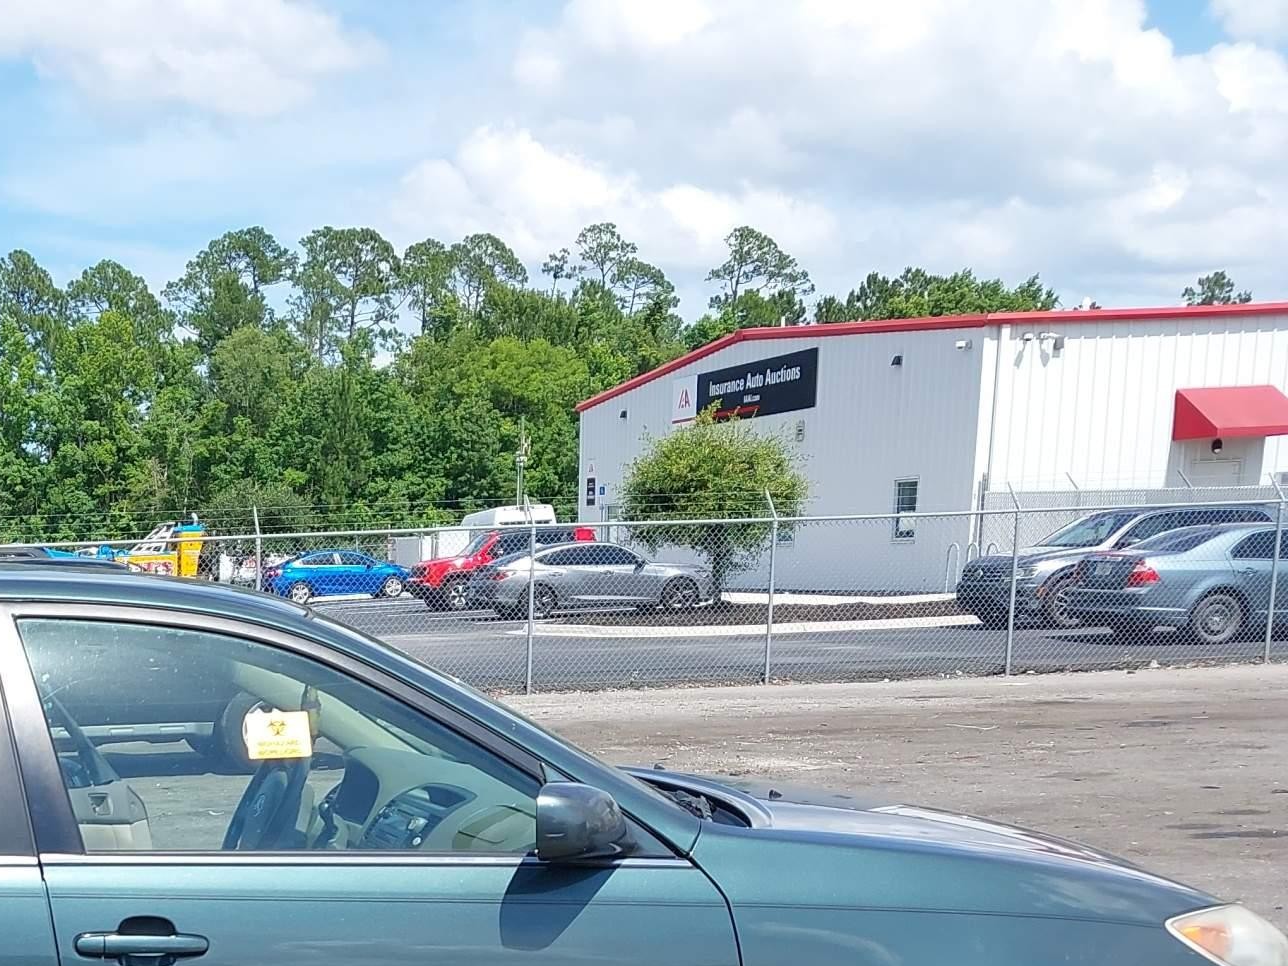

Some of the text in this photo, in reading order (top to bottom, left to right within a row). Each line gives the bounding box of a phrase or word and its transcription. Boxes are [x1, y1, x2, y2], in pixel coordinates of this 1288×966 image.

[709, 365, 800, 396] Insurance Auto Auctions
